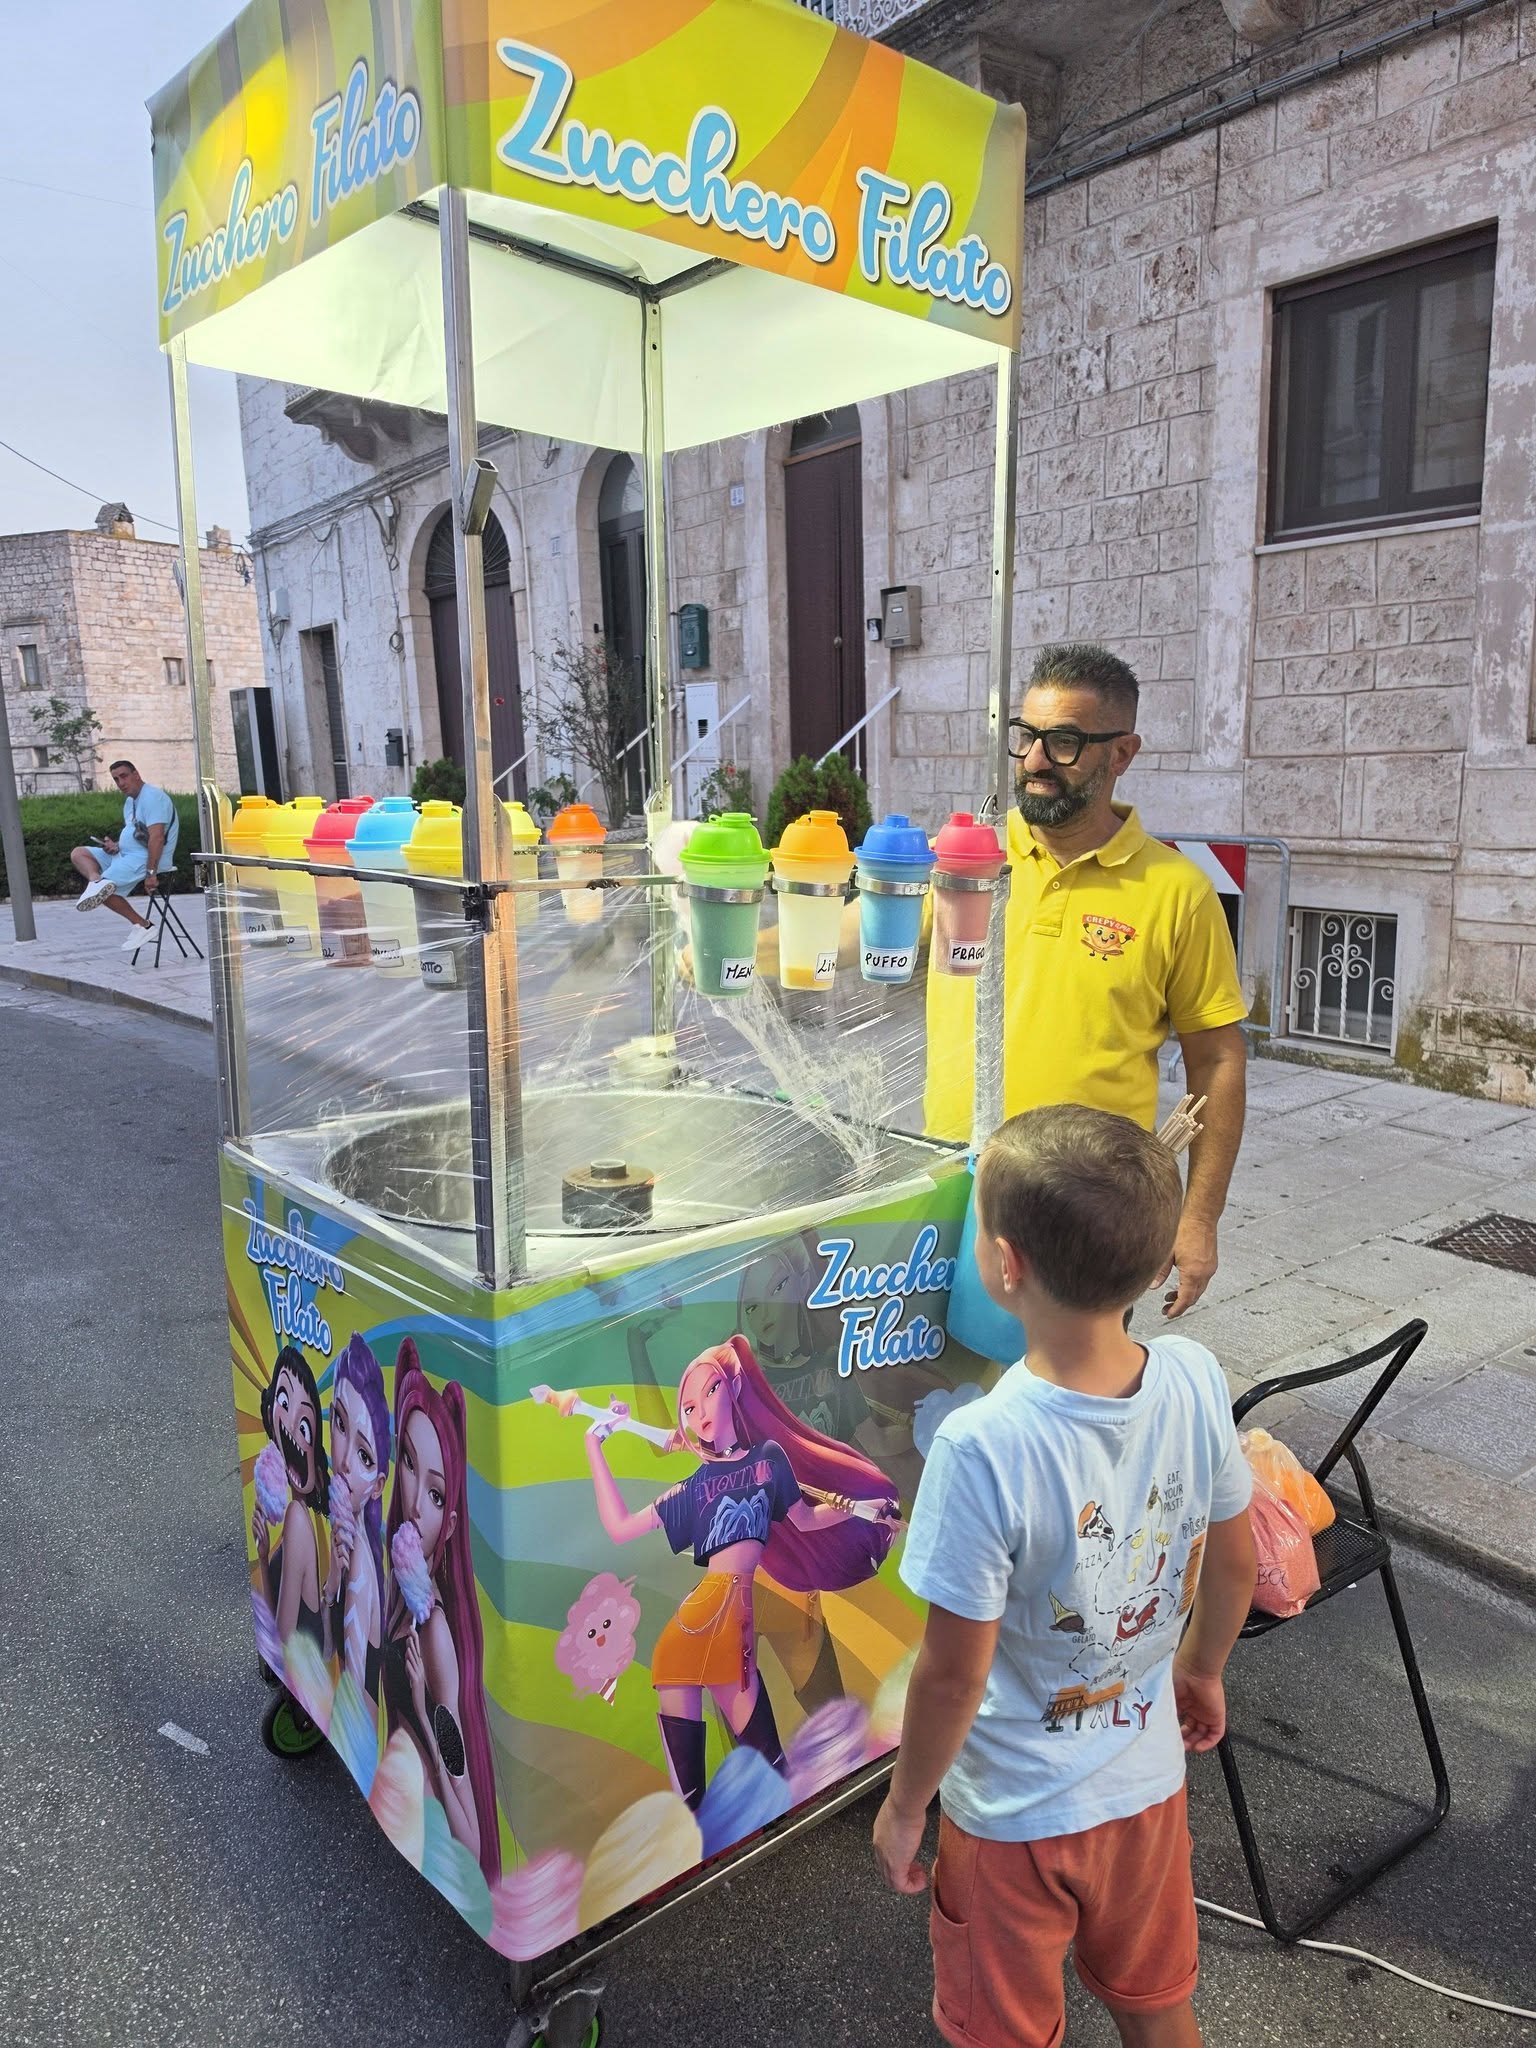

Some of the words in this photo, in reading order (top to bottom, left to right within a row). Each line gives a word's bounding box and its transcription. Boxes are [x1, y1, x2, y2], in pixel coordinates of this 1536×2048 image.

[163, 158, 298, 316] Zucchero
[310, 57, 421, 228] Filato
[497, 37, 836, 263] Zucchero
[857, 166, 1012, 316] Filato
[865, 952, 908, 968] PUFFO
[243, 1197, 345, 1293] Zucchero
[264, 1268, 332, 1356] Filato
[838, 1296, 946, 1378] Filato
[1164, 1483, 1184, 1501] YOUR
[1167, 1470, 1180, 1485] EAT
[1163, 1496, 1184, 1515] PASTE
[1072, 1632, 1097, 1644] GELATO
